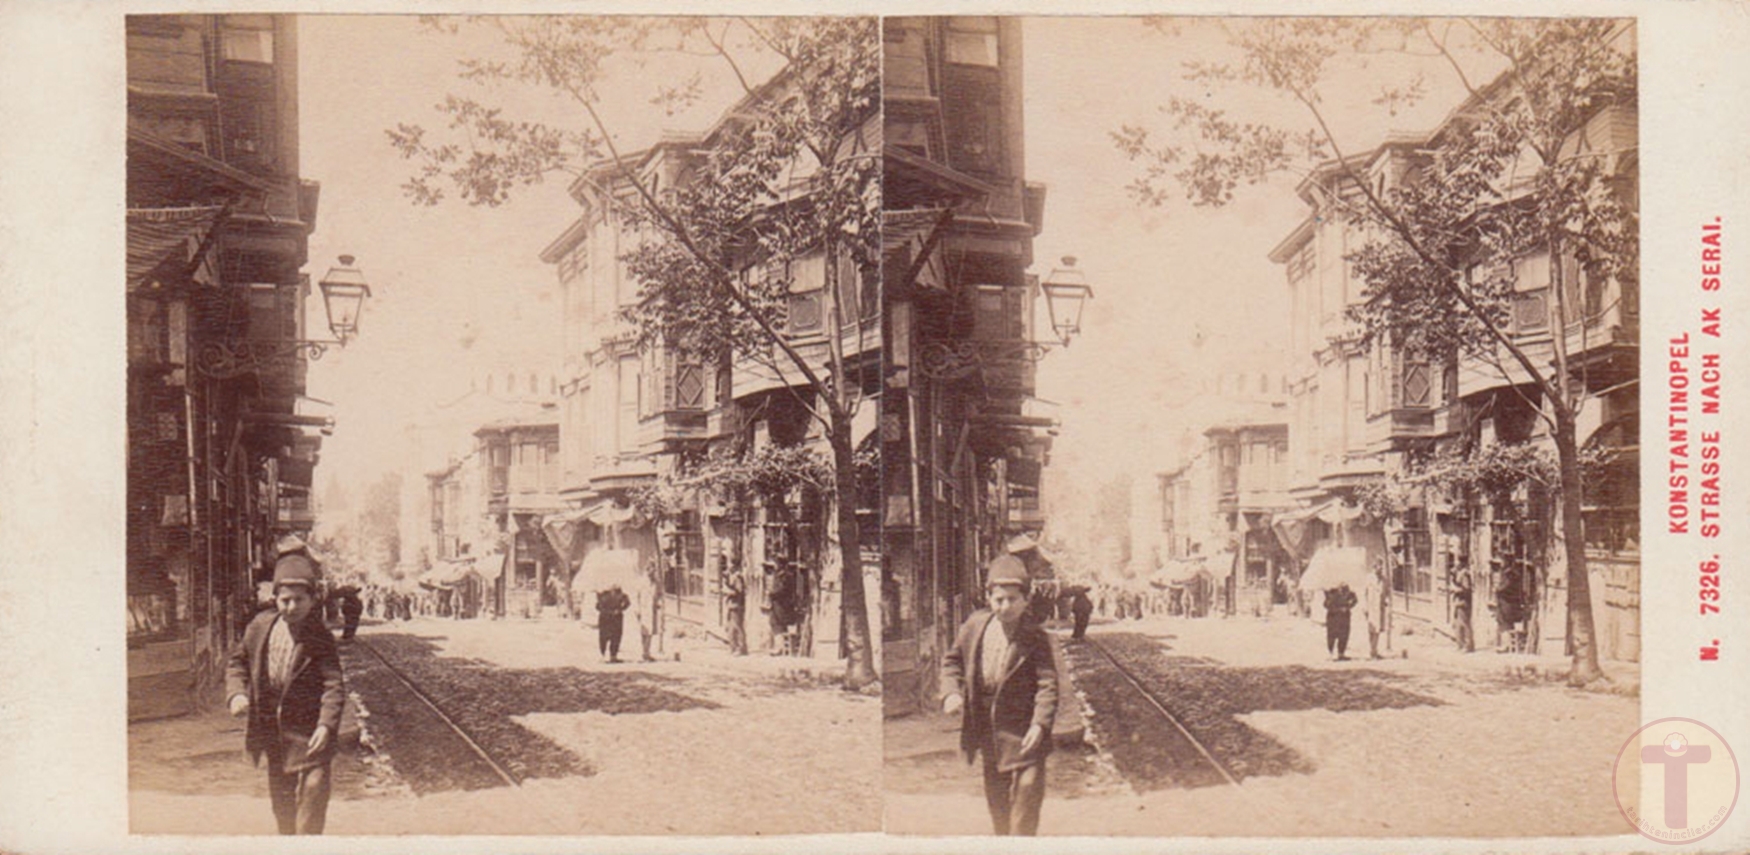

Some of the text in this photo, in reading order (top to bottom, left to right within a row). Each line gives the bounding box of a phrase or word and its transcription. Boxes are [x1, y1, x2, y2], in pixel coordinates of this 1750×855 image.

[1669, 332, 1689, 534] KONSTANTINOPEL
[1699, 216, 1721, 661] N. 7326. STRASSE NACH AK SERAI.
